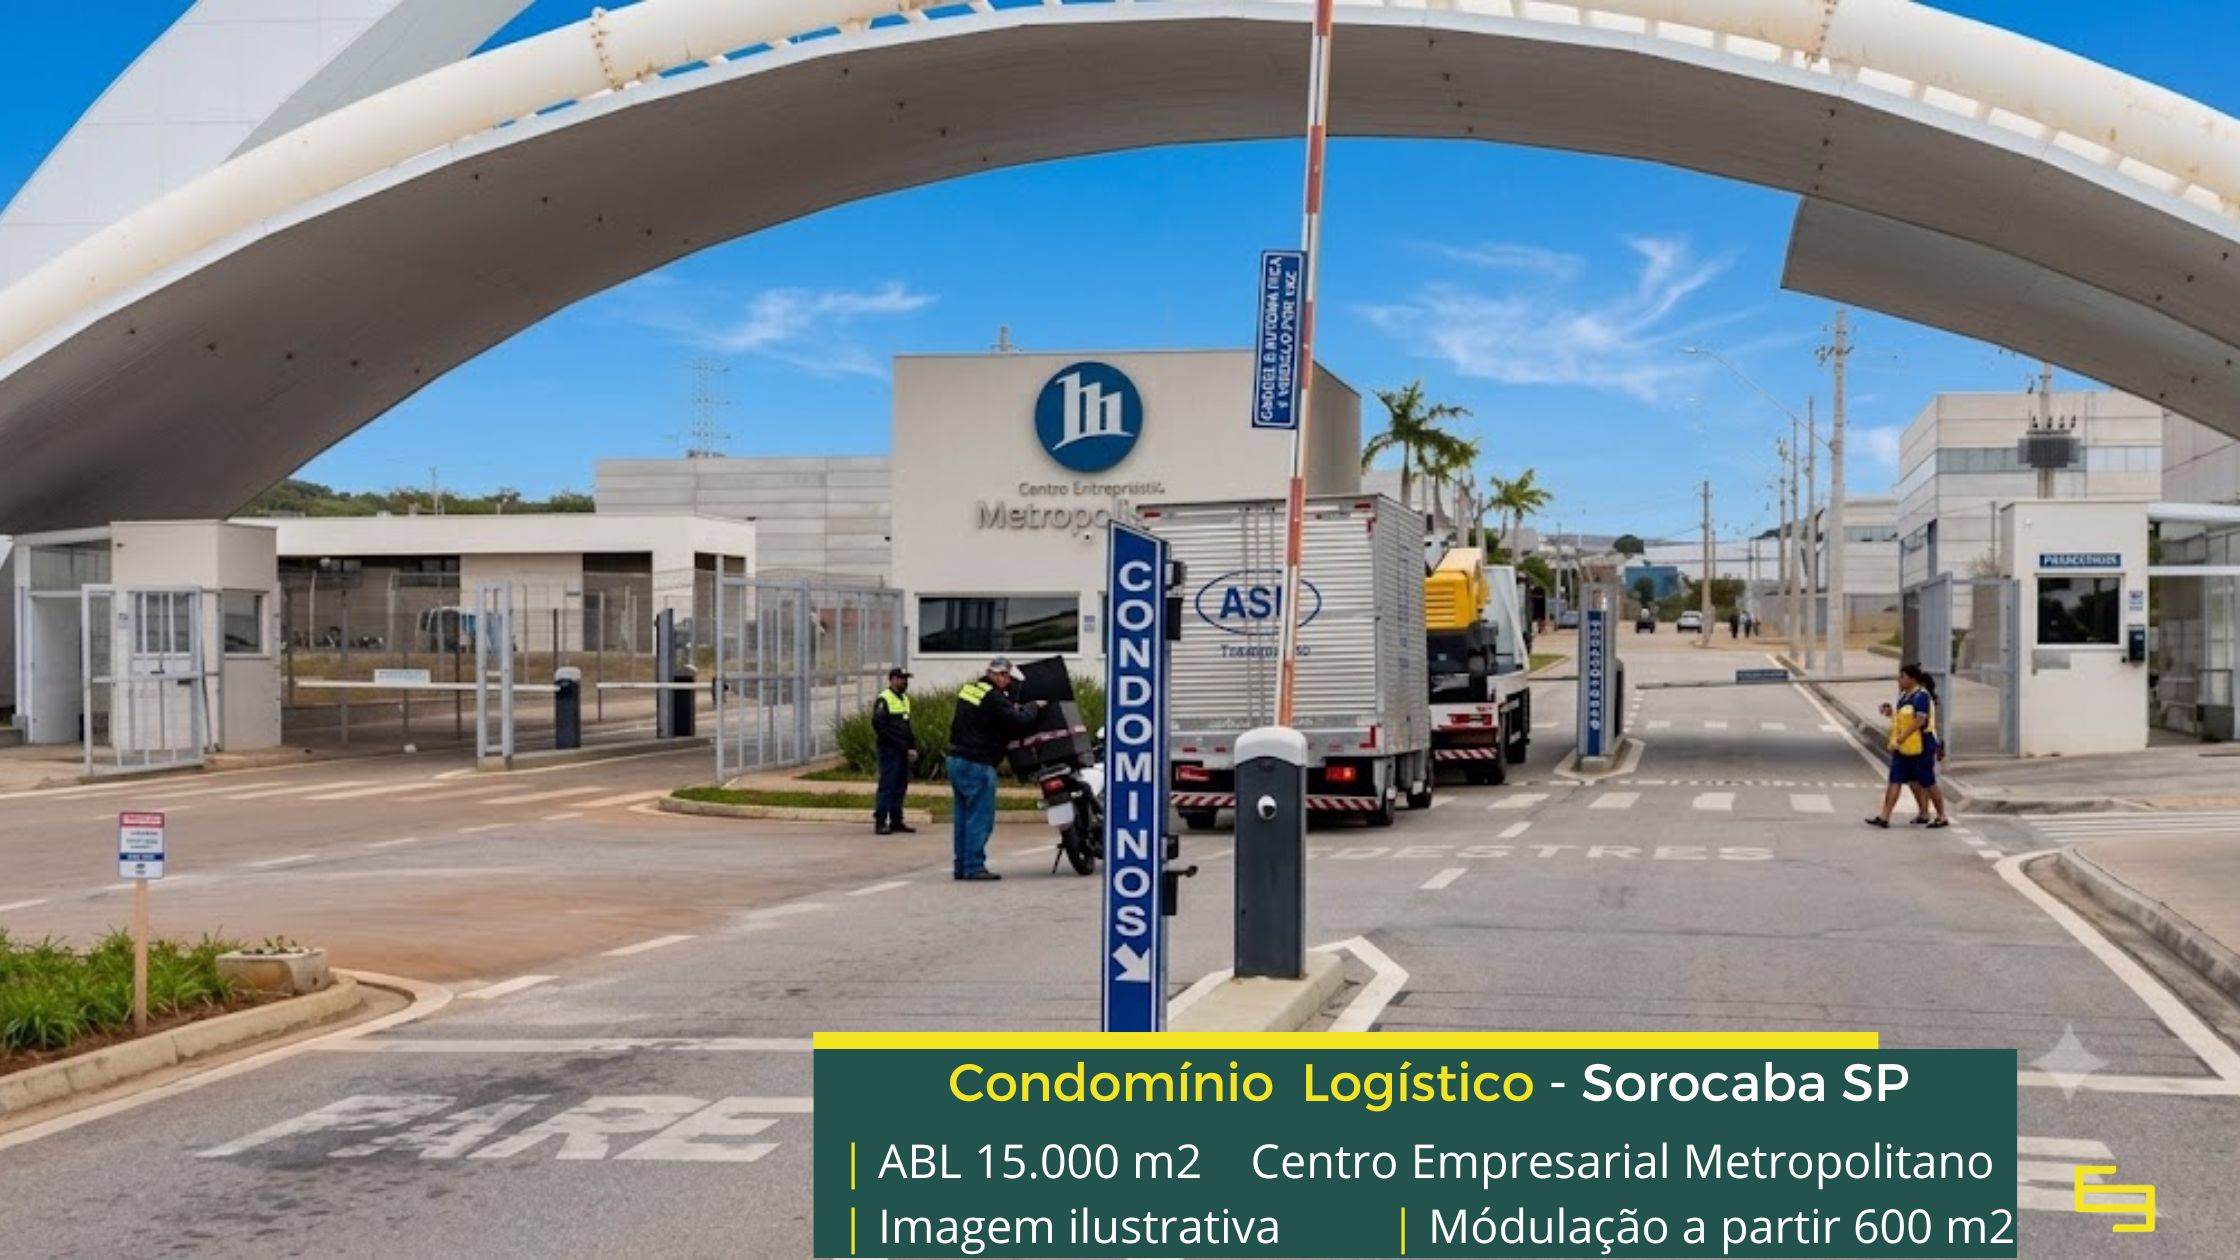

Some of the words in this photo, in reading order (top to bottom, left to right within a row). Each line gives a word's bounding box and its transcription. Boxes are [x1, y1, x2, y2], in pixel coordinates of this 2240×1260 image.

[1018, 481, 1069, 497] Centro
[1112, 560, 1155, 937] CONDOMINOS
[194, 1095, 814, 1162] PARE
